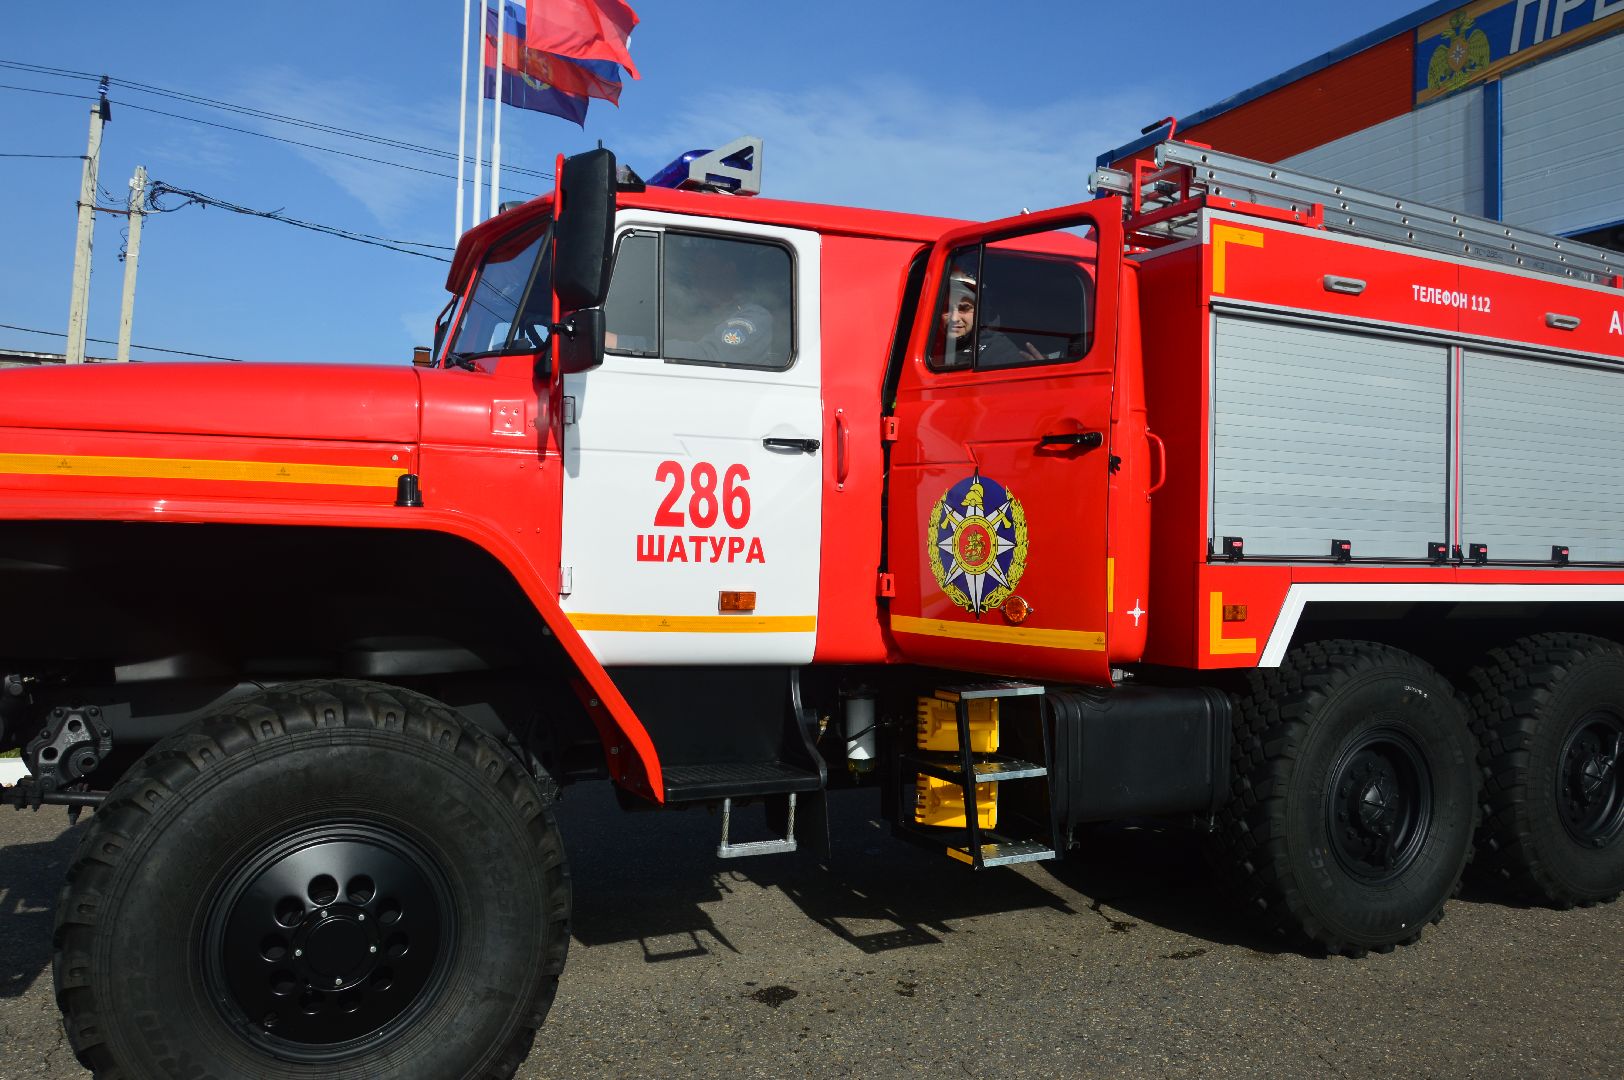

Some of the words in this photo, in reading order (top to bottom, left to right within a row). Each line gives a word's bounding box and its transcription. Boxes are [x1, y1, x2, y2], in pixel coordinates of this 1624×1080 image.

[1412, 284, 1468, 309] ТЕЛЕФОН
[1471, 295, 1491, 313] 112
[1609, 310, 1624, 336] А
[654, 460, 751, 530] 286
[636, 534, 766, 564] ШАТУРА
